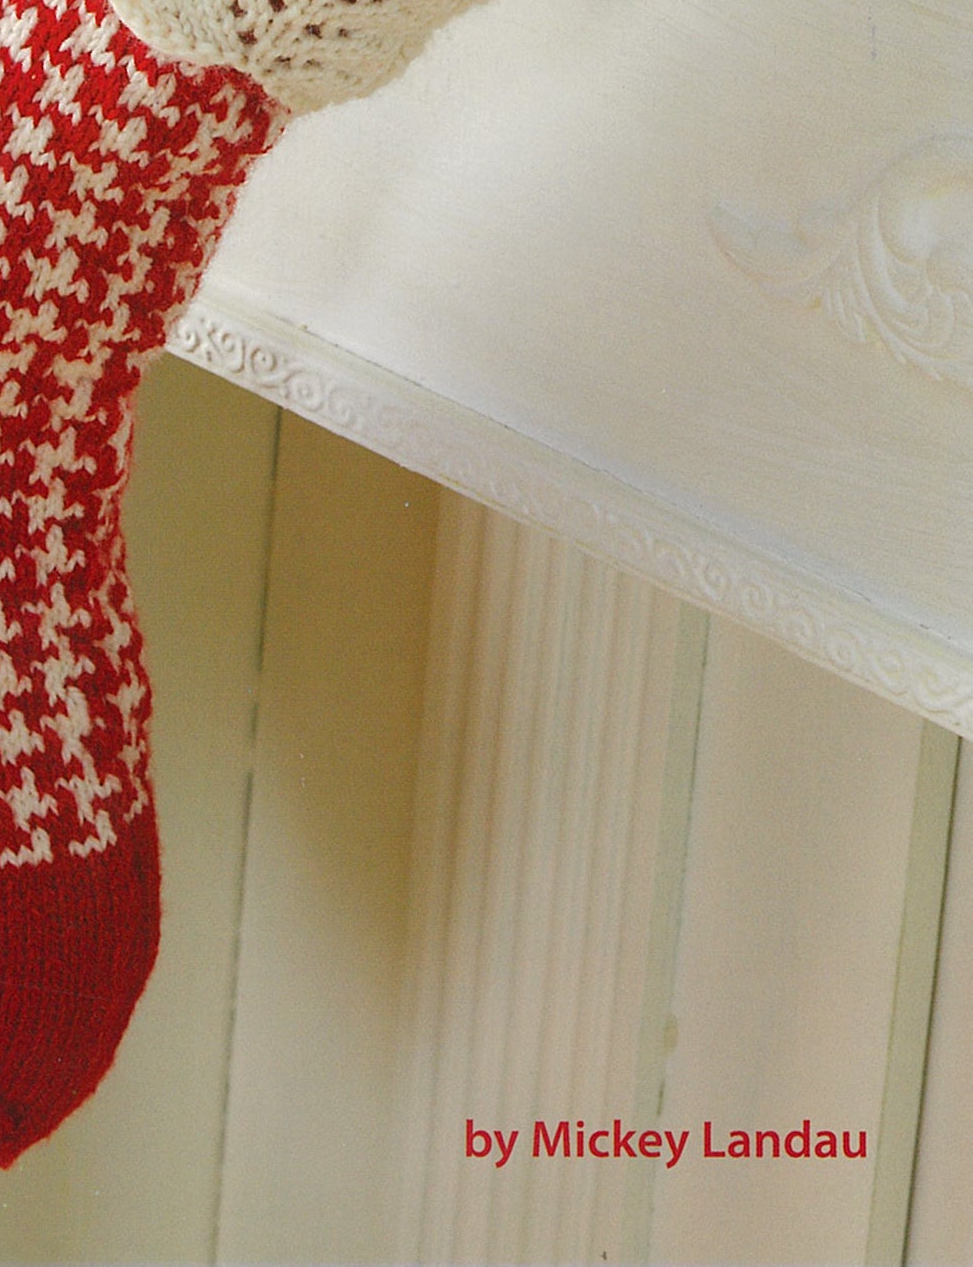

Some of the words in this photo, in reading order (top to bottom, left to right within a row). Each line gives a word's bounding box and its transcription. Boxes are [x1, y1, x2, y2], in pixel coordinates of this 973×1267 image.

[465, 1119, 519, 1168] by
[532, 1119, 690, 1168] Mickey
[703, 1119, 867, 1158] Landau
